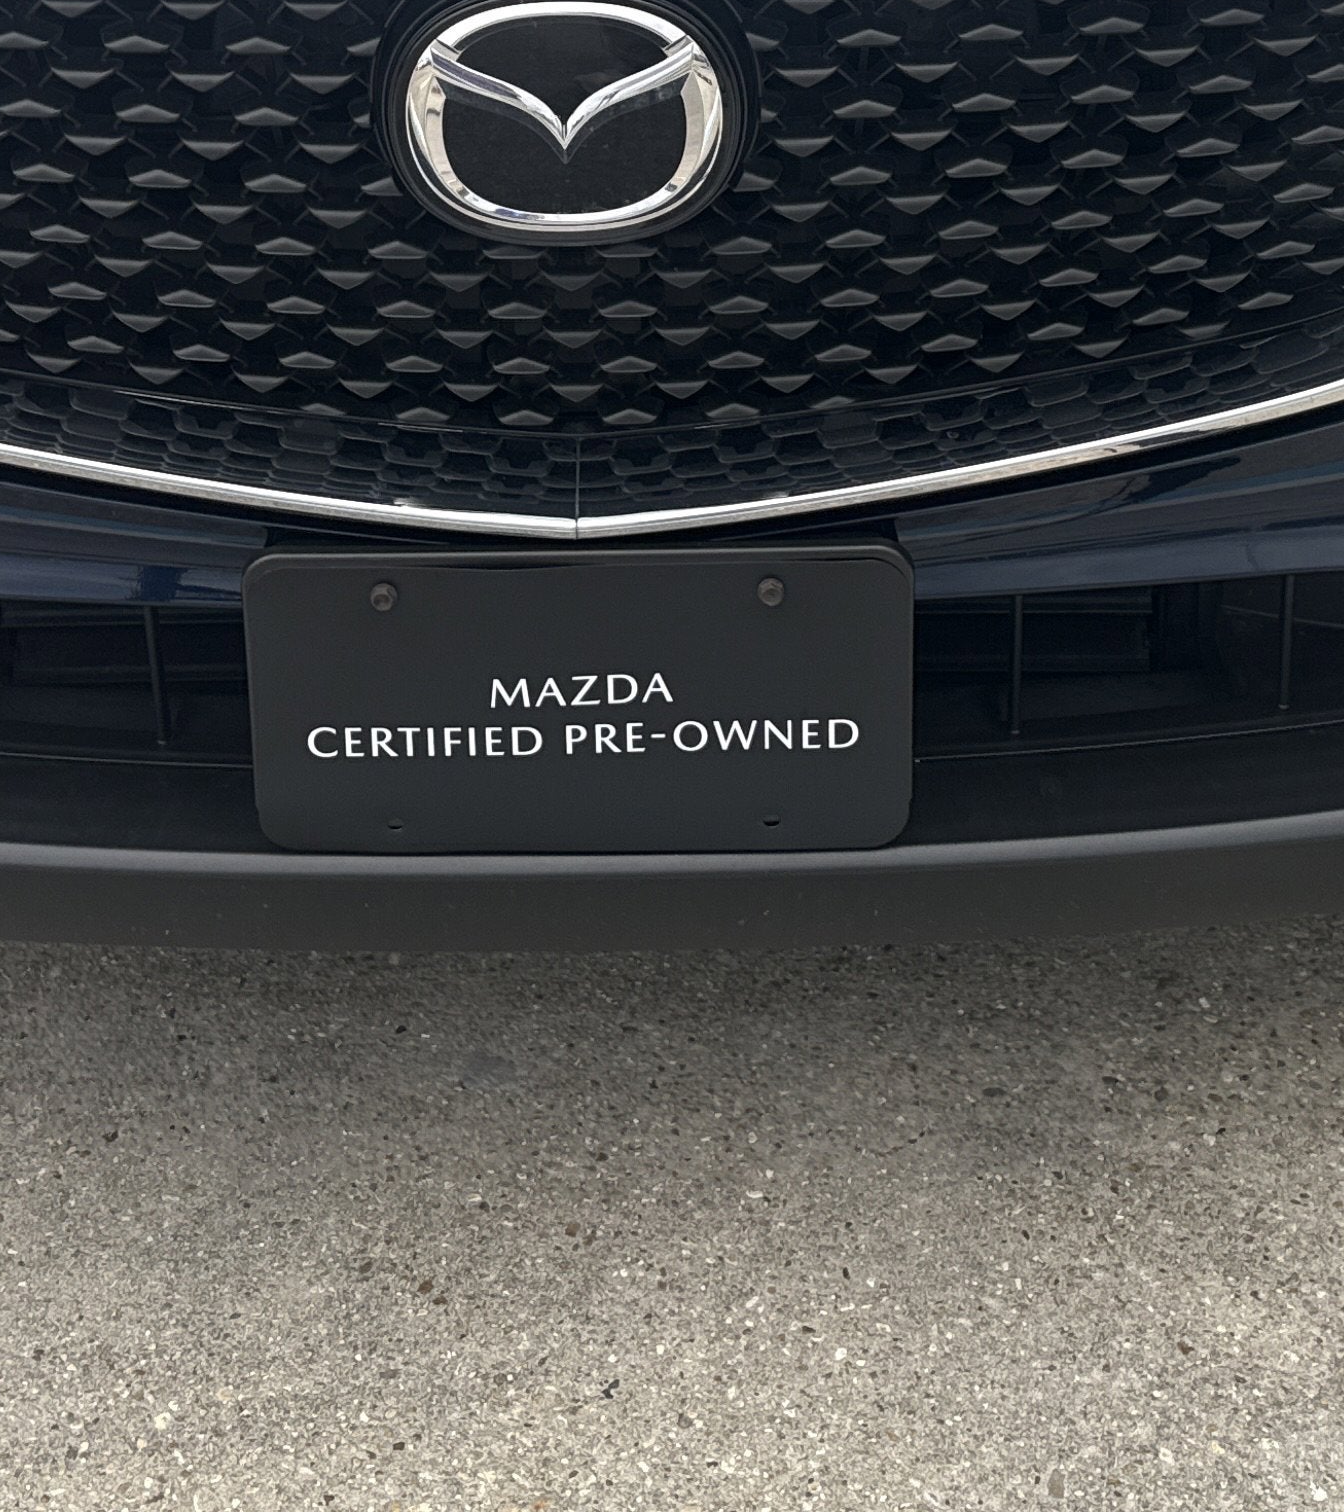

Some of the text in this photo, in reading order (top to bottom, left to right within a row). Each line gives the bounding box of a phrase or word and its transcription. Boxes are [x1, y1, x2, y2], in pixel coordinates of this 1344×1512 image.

[491, 673, 673, 708] MAZDA
[308, 719, 858, 757] CERTIFIED PRE-OWNED
